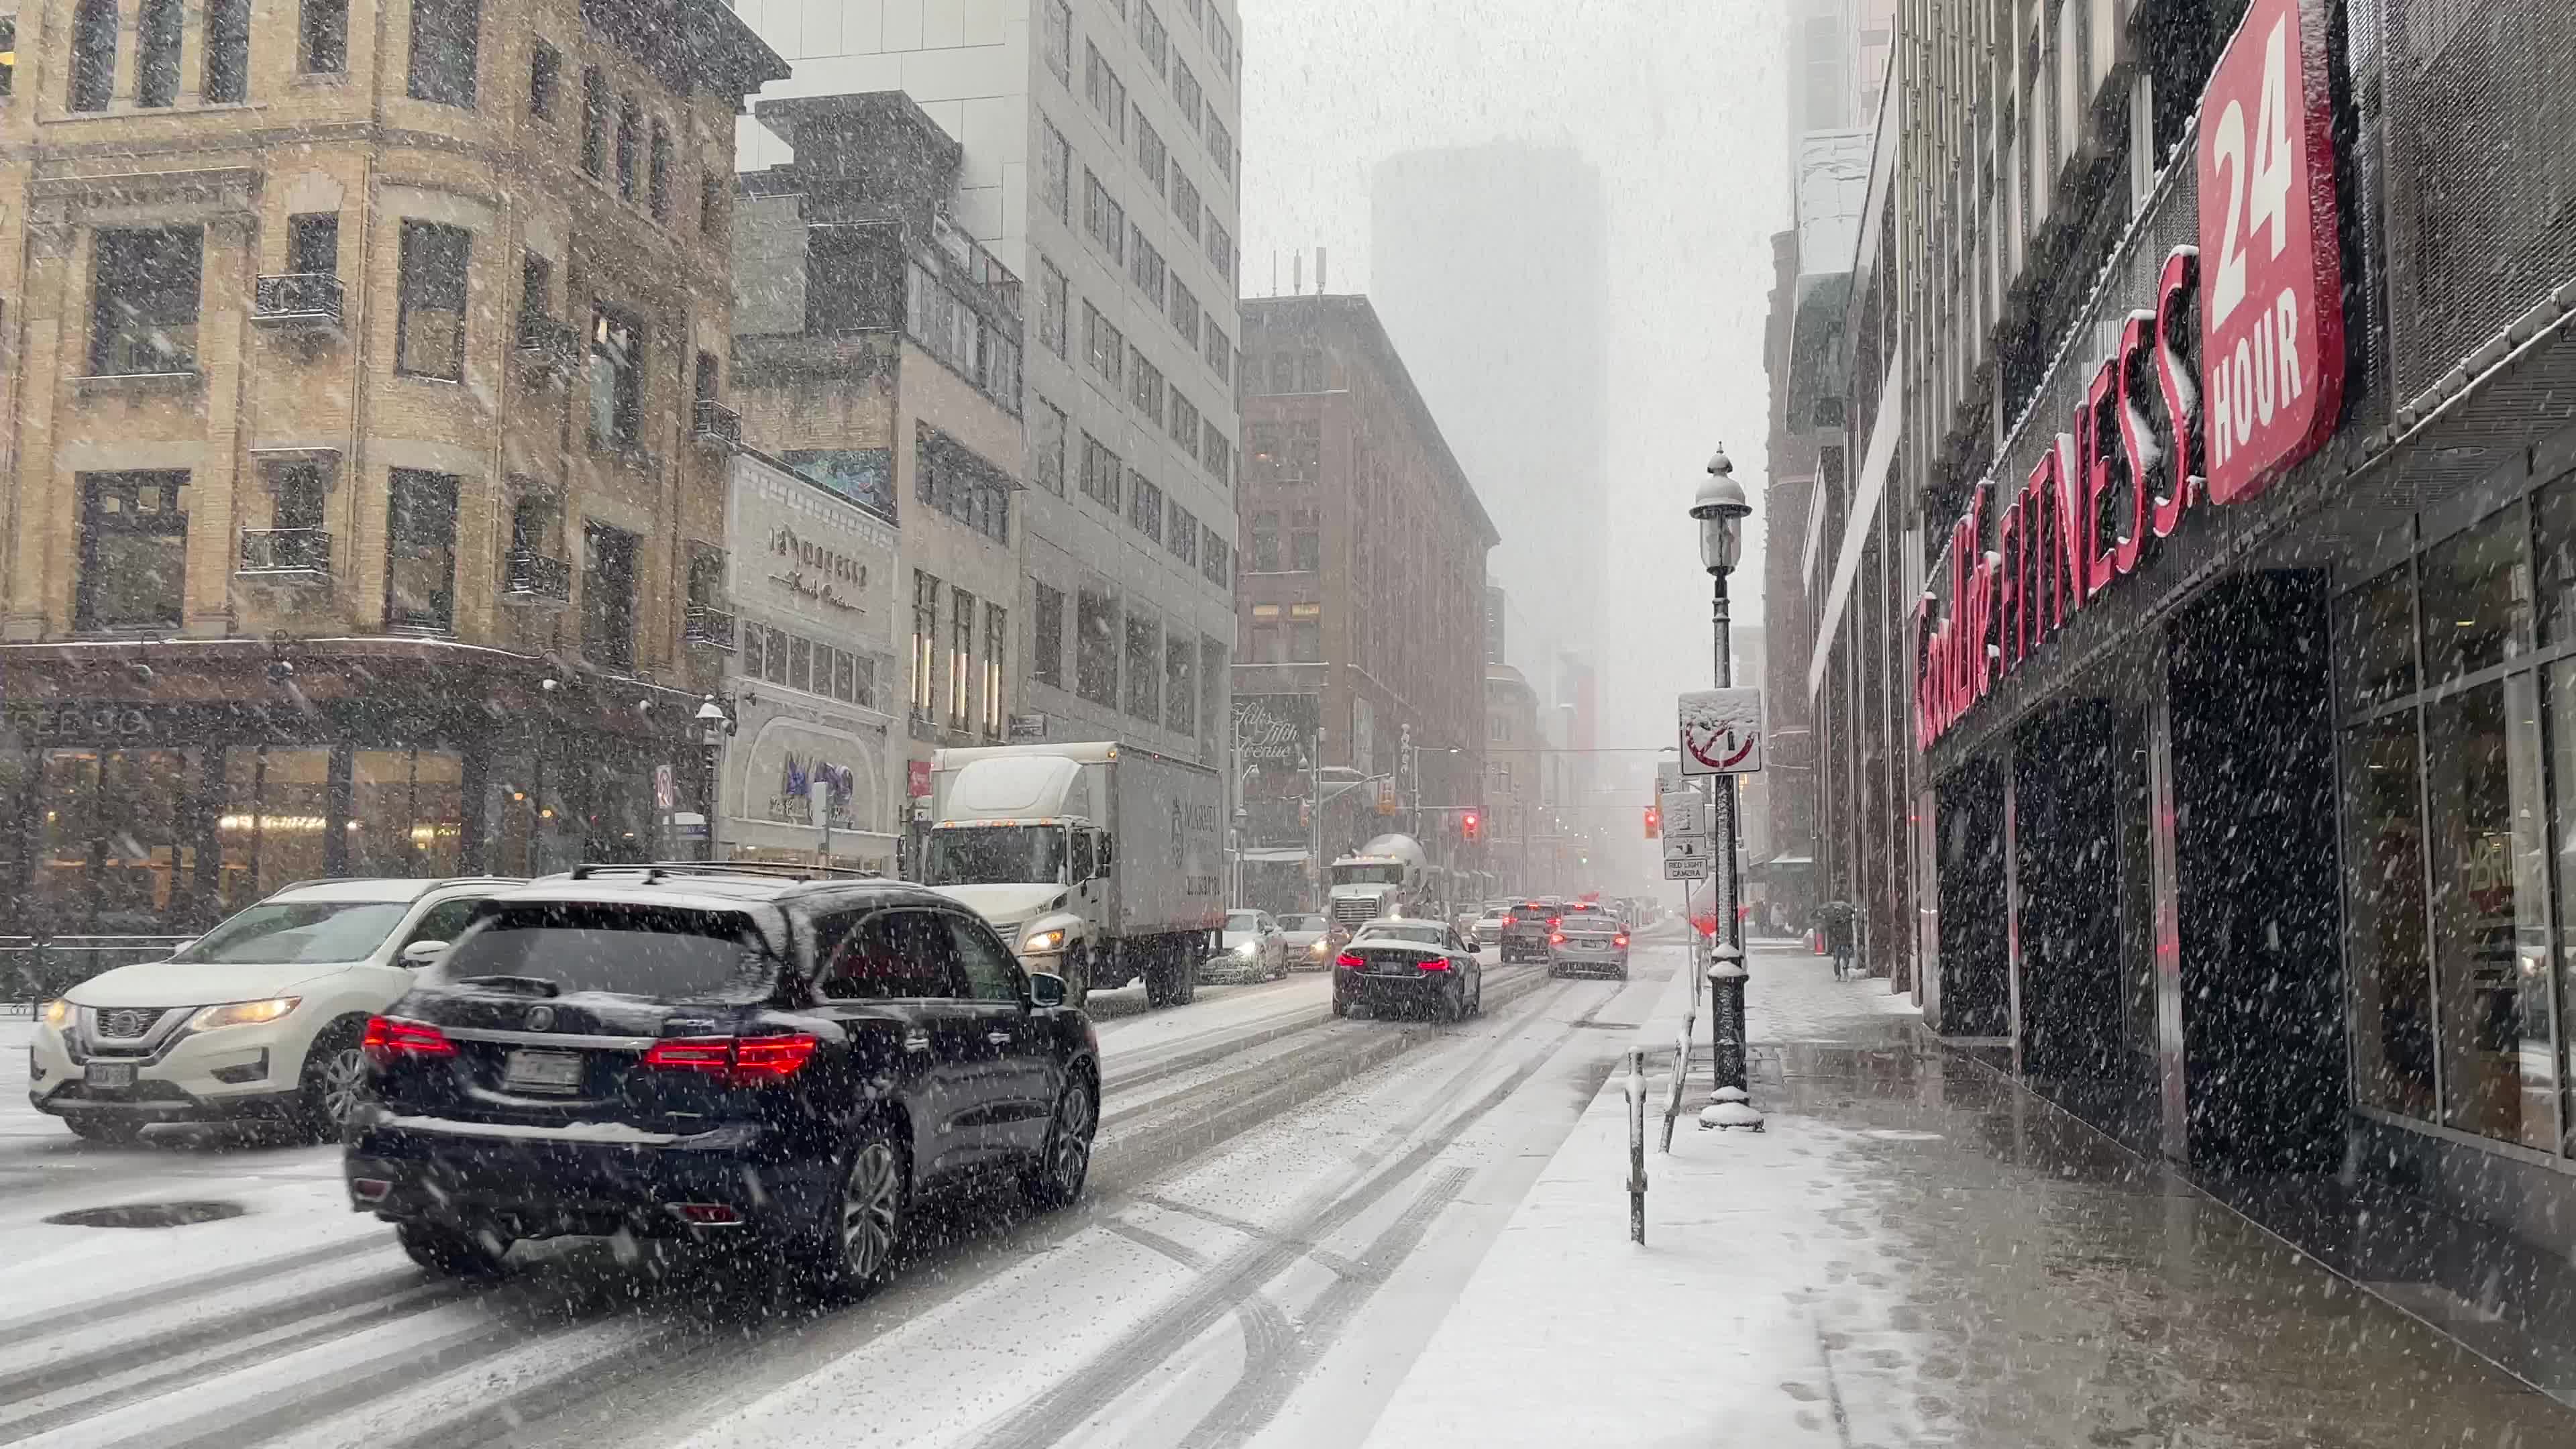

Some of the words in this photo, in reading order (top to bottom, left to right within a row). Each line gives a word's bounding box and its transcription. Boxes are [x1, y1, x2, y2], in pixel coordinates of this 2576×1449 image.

[2212, 11, 2292, 334] 24
[1999, 246, 2194, 680] FITNESS
[2212, 287, 2302, 470] HOUR
[1672, 869, 1701, 877] CAMERA
